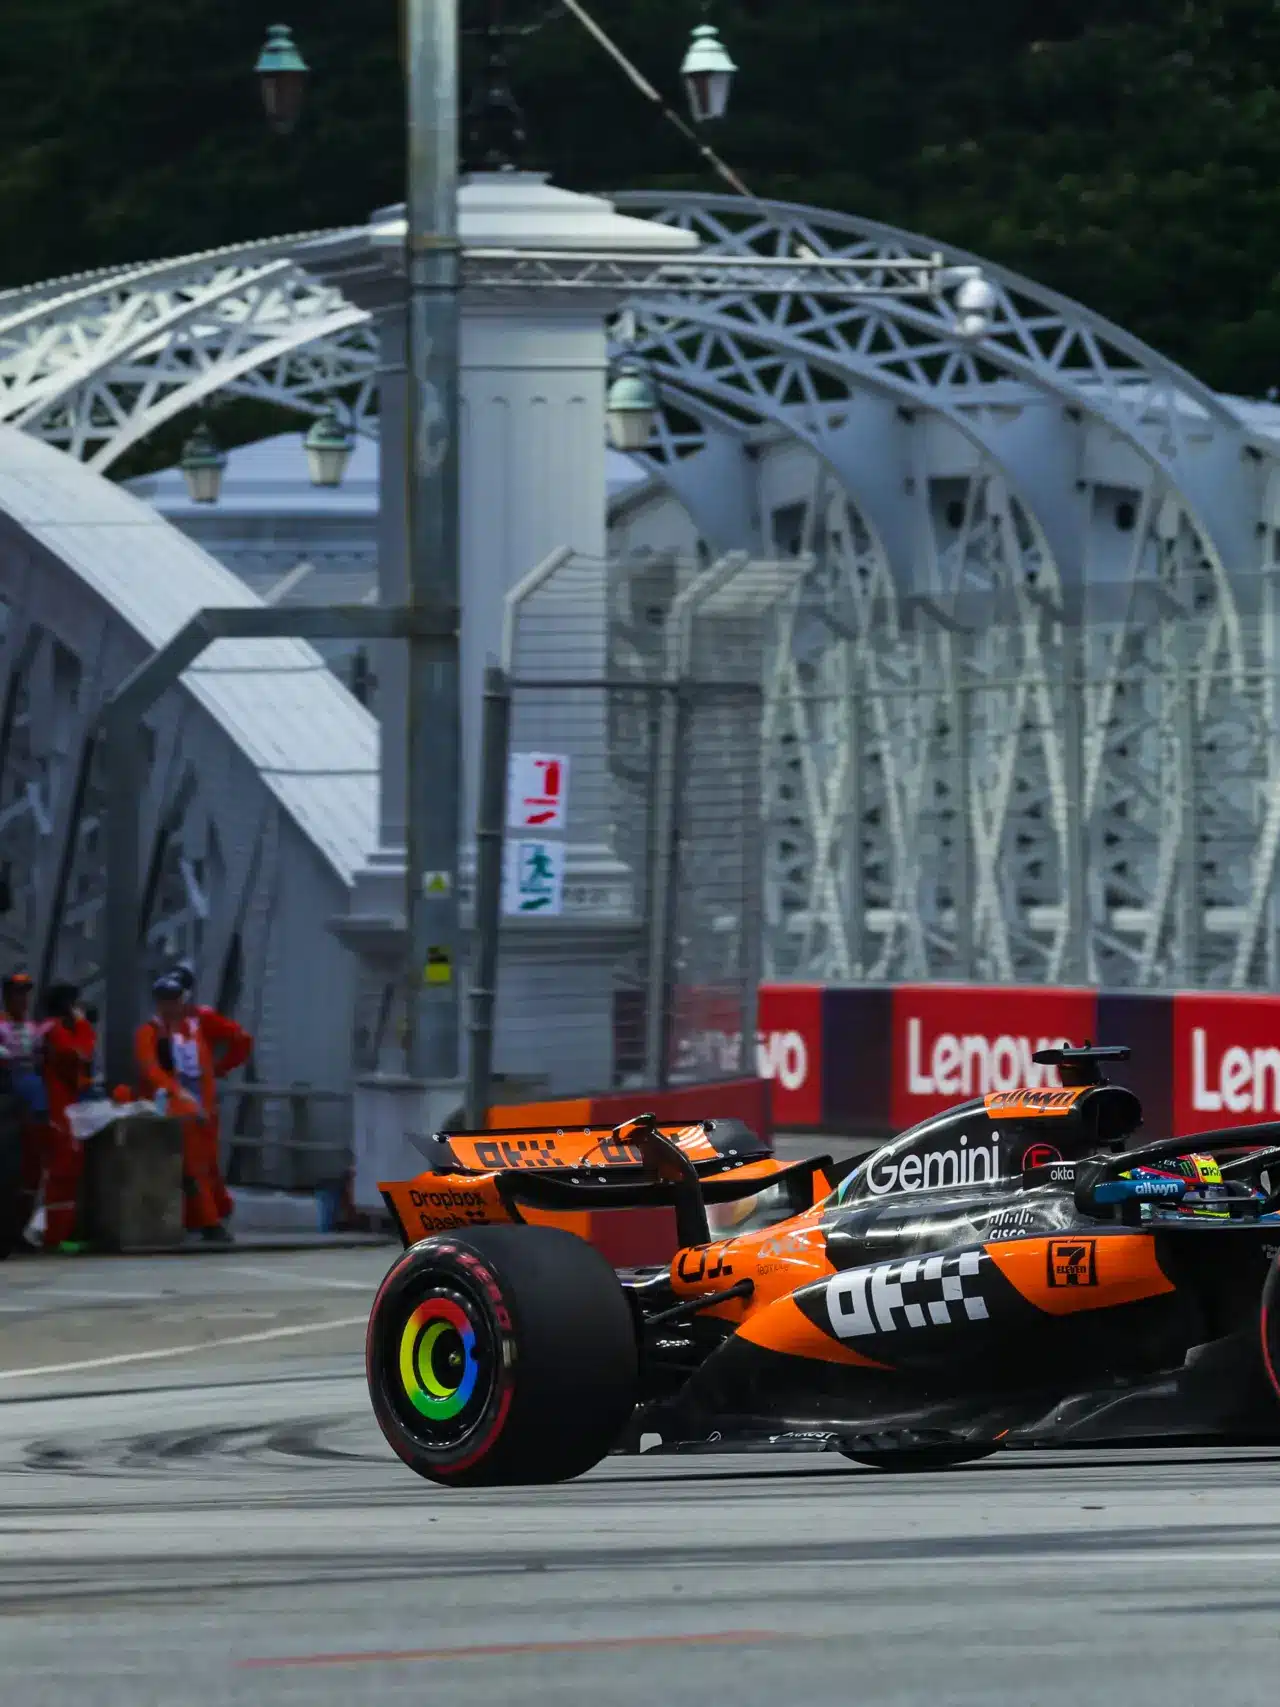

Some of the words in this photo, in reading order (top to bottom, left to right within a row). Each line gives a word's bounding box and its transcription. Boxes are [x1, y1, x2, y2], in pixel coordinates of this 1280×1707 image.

[473, 1139, 564, 1168] OKX
[866, 1131, 1000, 1194] Gemini
[1050, 1166, 1075, 1181] okta
[408, 1189, 486, 1209] Dropbox
[1135, 1181, 1179, 1197] allwyn
[419, 1211, 464, 1231] Dash
[826, 1251, 990, 1339] OKX
